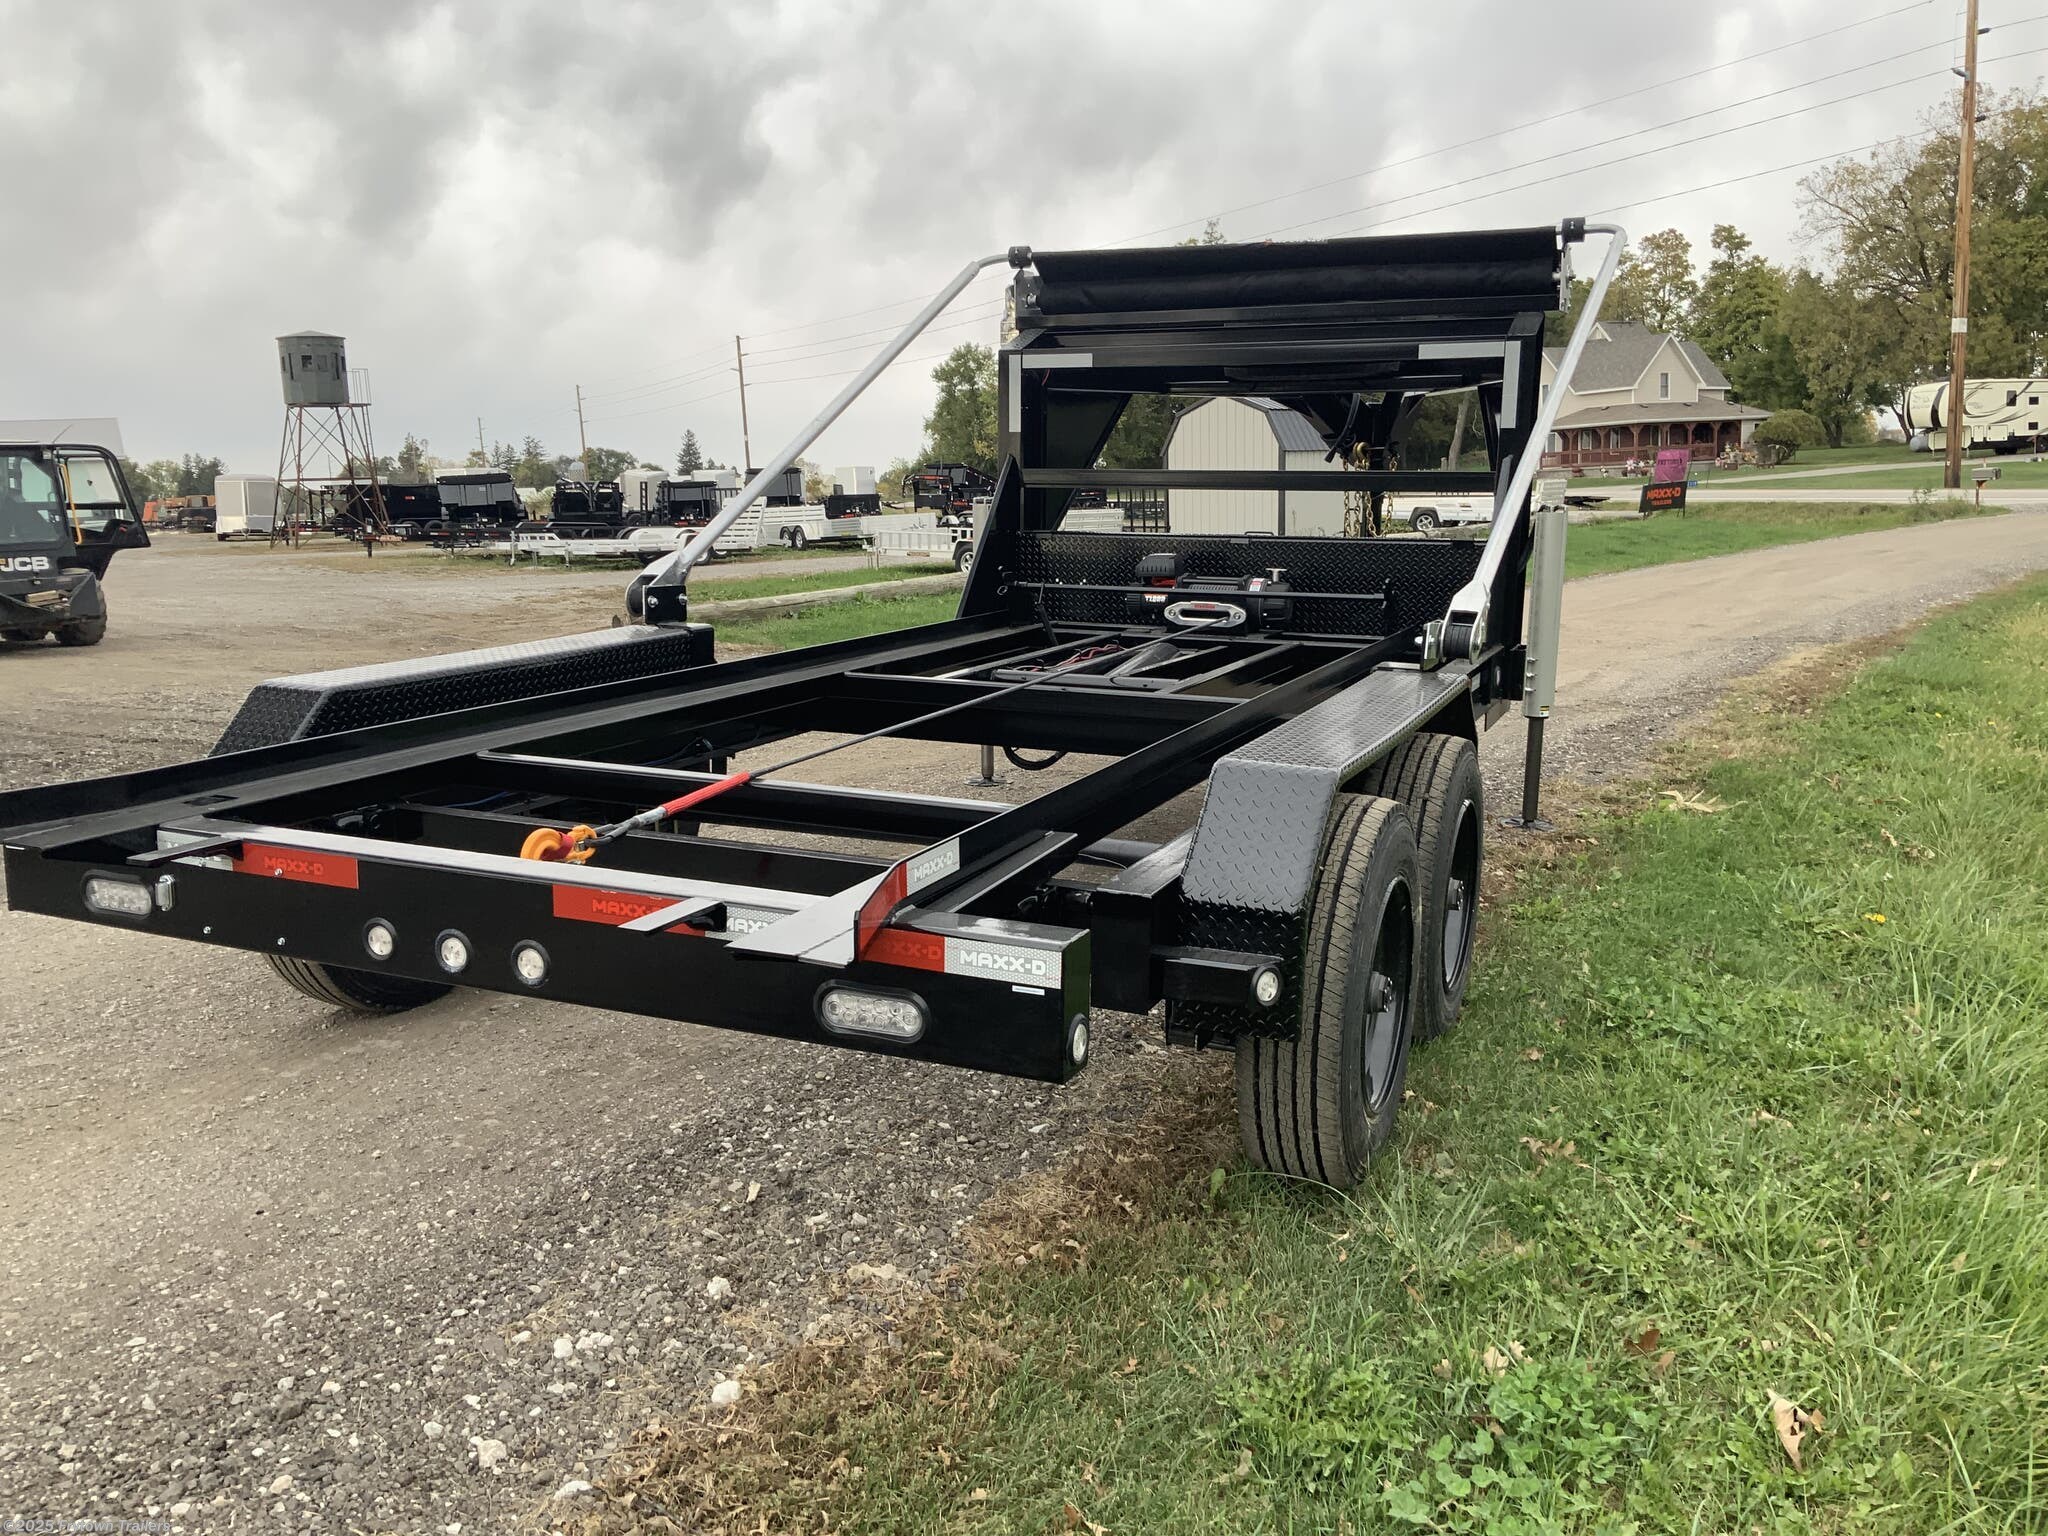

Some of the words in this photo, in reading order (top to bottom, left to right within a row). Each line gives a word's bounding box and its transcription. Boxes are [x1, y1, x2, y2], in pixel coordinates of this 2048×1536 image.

[1647, 487, 1681, 499] MAXX-D
[0, 556, 50, 571] JCB
[264, 856, 324, 875] MAXX-D
[913, 851, 954, 882] MAXX-D
[959, 950, 1047, 975] MAXX-D
